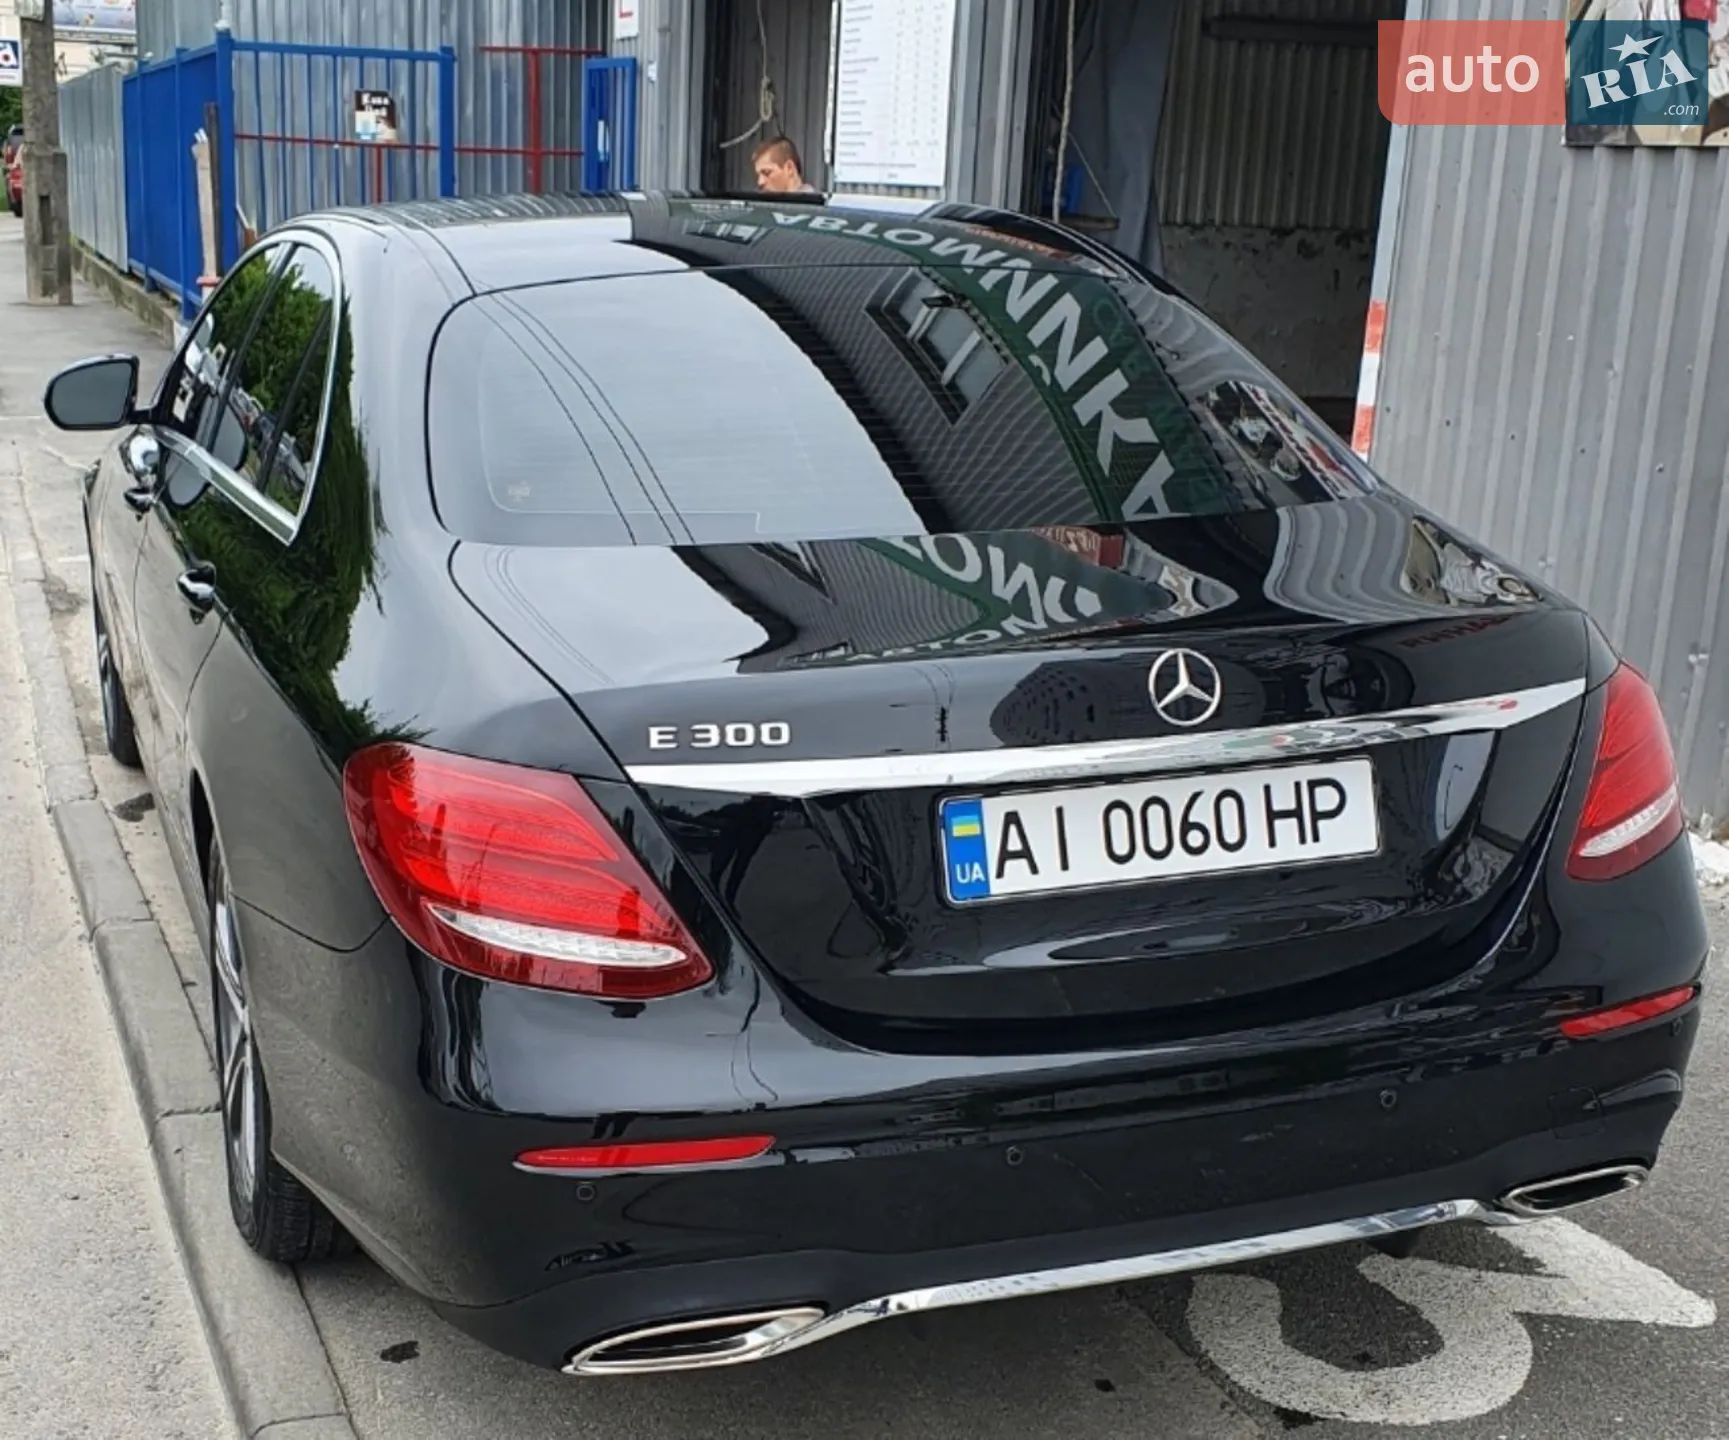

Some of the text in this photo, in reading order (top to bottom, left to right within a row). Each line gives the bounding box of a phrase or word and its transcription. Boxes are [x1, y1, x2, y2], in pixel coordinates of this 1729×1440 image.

[648, 722, 790, 749] E 300
[1102, 788, 1247, 865] 0060
[1264, 777, 1347, 849] HP
[956, 863, 986, 885] UA
